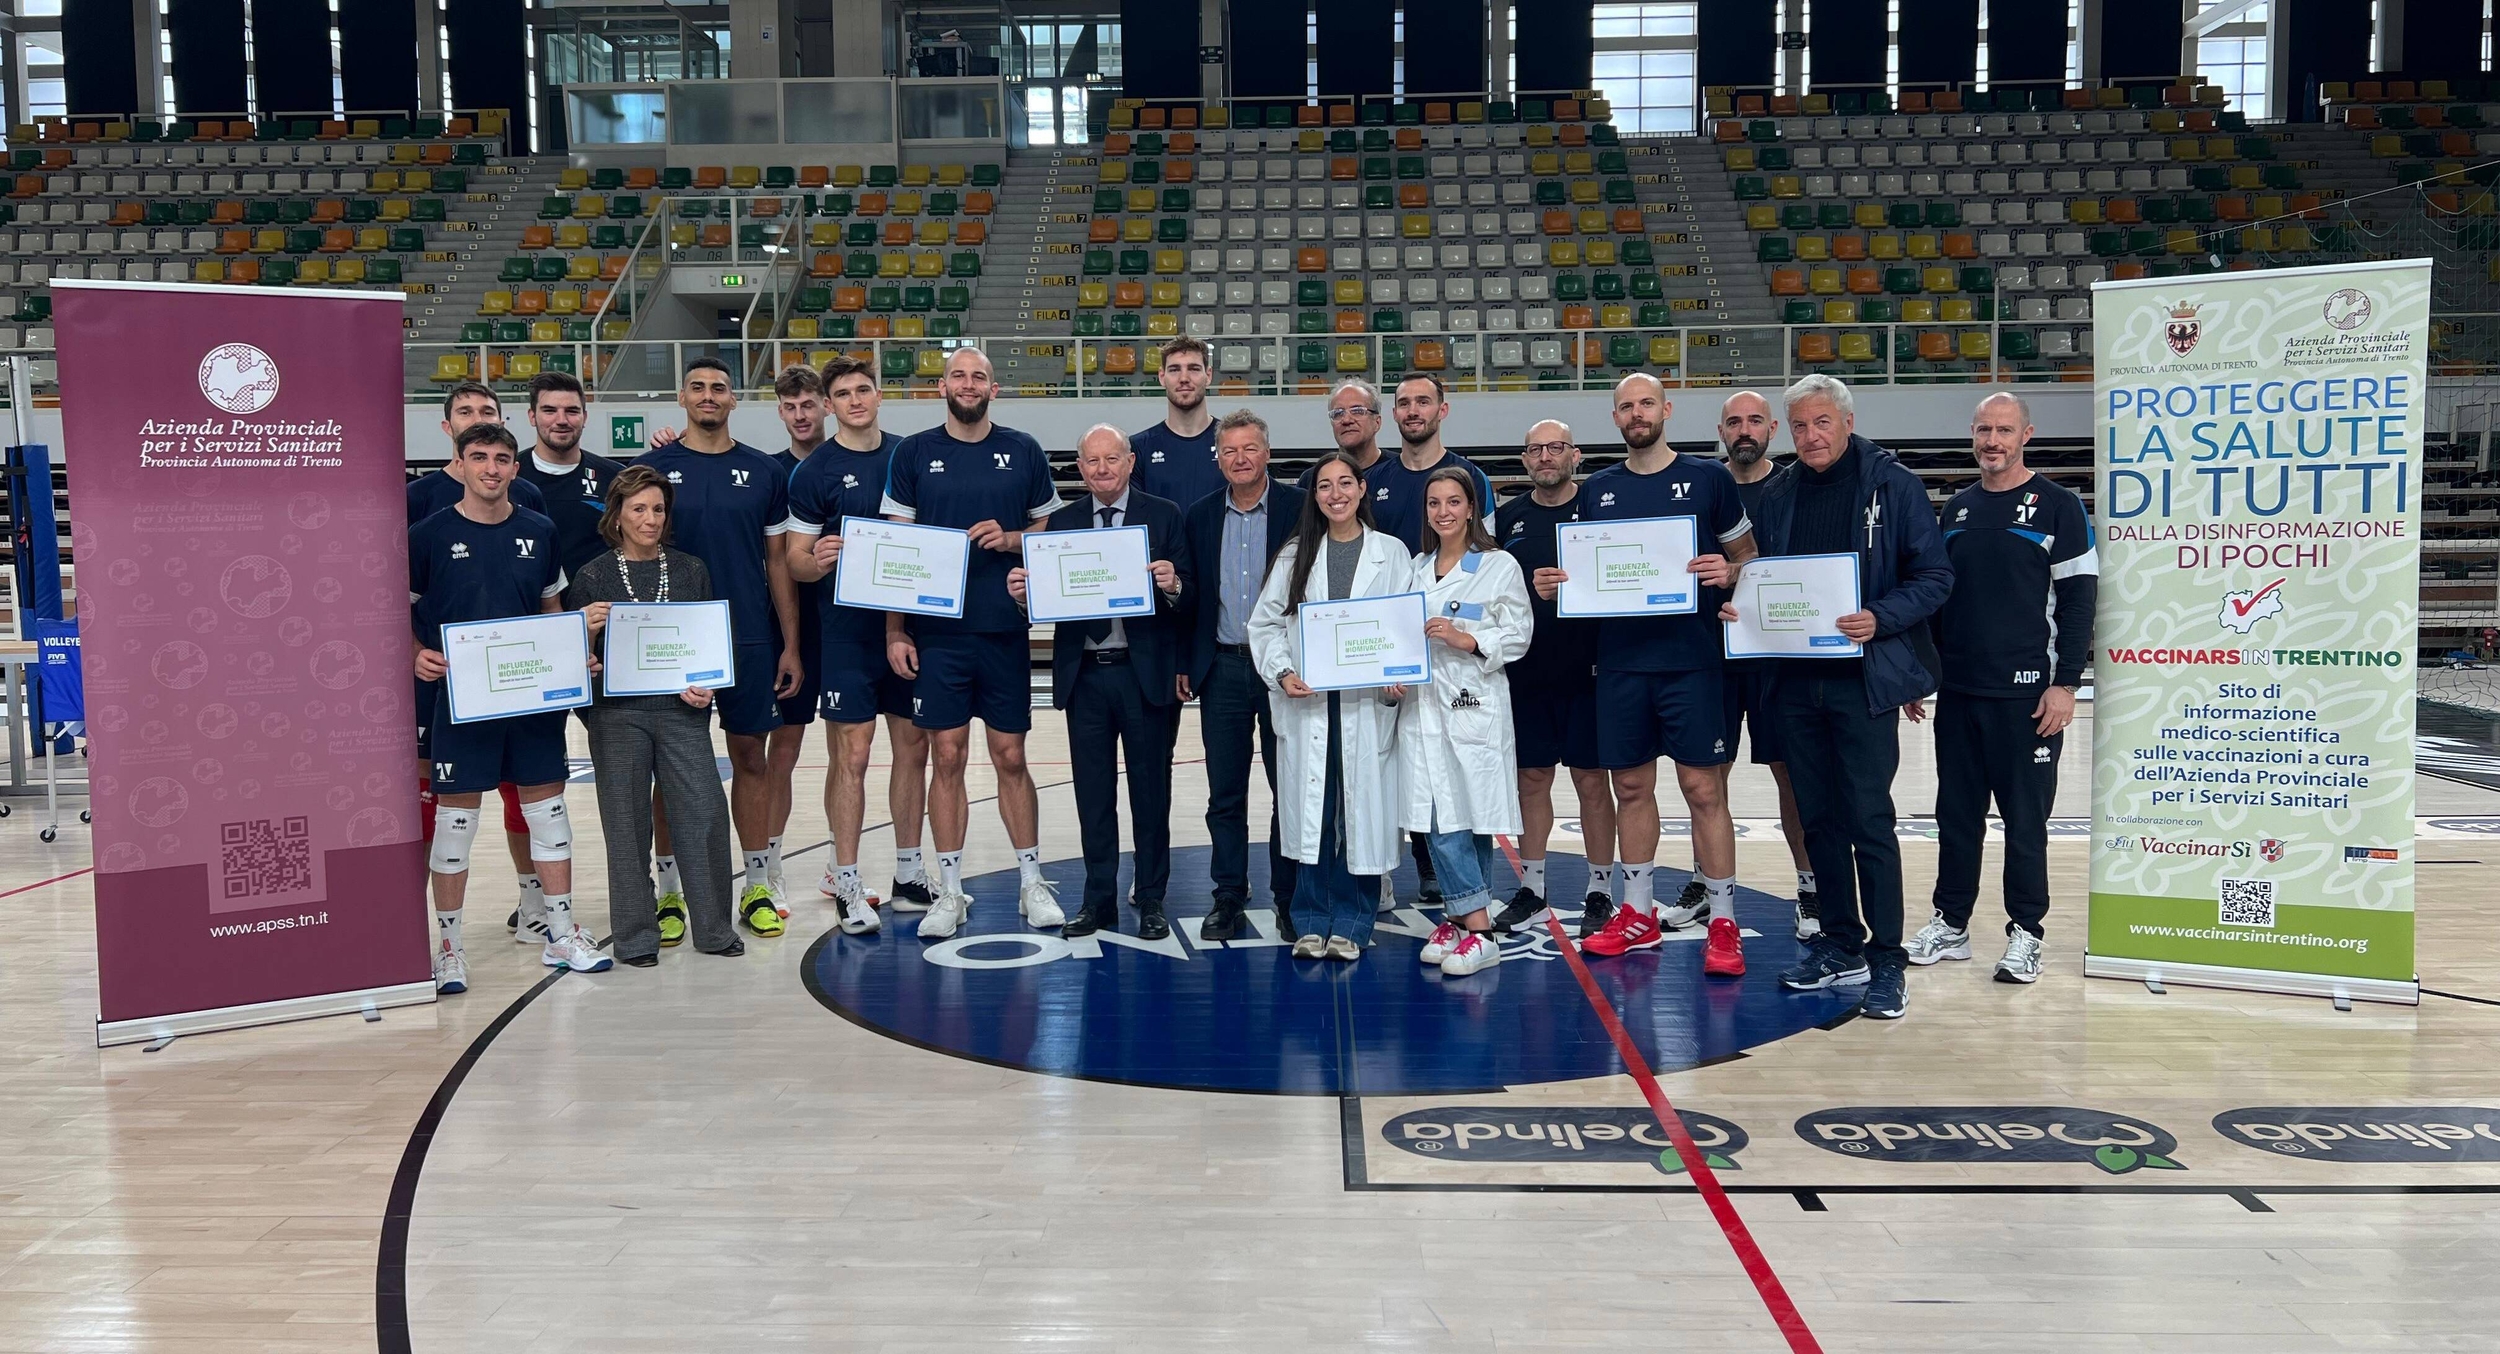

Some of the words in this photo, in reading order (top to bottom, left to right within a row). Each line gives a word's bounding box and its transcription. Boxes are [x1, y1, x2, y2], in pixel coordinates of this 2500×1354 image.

[1062, 186, 1081, 194] FILA
[470, 223, 476, 231] 7
[1073, 245, 1080, 253] 6
[1663, 268, 1685, 276] FILA
[1689, 267, 1696, 275] 5
[1043, 278, 1064, 286] FILA
[1068, 277, 1074, 285] 5
[402, 286, 423, 294] FILA
[427, 285, 433, 293] 5
[1674, 301, 1694, 310] FILA
[1699, 301, 1706, 309] 4
[1036, 311, 1058, 320] FILA
[1060, 311, 1068, 319] 4
[403, 319, 411, 327] 4
[2285, 335, 2335, 347] Azienda
[2339, 331, 2410, 344] Provinciale
[1030, 347, 1052, 355] FILA
[1055, 347, 1062, 355] 3
[2285, 349, 2304, 360] per
[2308, 348, 2312, 356] i
[2316, 345, 2358, 356] Servizi
[2361, 342, 2410, 353] Sanitari
[2110, 366, 2155, 375] PROVINCIA
[2158, 364, 2208, 373] AUTONOMA
[2212, 362, 2221, 370] DI
[2223, 361, 2258, 369] TRENTO
[2109, 376, 2409, 420] PROTEGGERE
[139, 419, 224, 436] Azienda
[230, 419, 342, 436] Provinciale
[2109, 424, 2174, 464] LA
[2190, 415, 2407, 461] SALUTE
[139, 439, 175, 457] per
[180, 437, 187, 452] i
[193, 437, 262, 452] Servizi
[266, 437, 342, 453] Sanitari
[140, 456, 208, 468] Provincia
[211, 456, 281, 467] Autonoma
[284, 455, 297, 467] di
[302, 456, 343, 467] Trento
[2108, 469, 2171, 518] DI
[2196, 461, 2407, 517] TUTTI
[2108, 525, 2178, 541] DALLA
[2185, 520, 2405, 540] DISINFORMAZIONE
[452, 551, 469, 559] errea
[2178, 545, 2209, 569] DI
[2221, 544, 2328, 569] POCHI
[883, 561, 925, 571] INFLUENZA?
[1606, 562, 1650, 571] INFLUENZA?
[1069, 568, 1109, 578] INFLUENZA?
[1767, 602, 1811, 611] INFLUENZA?
[646, 643, 687, 651] INFLUENZA?
[1345, 637, 1386, 647] INFLUENZA?
[498, 659, 543, 670] INFLUENZA?
[2014, 671, 2040, 683] ADP
[2218, 683, 2257, 699] Sito
[2263, 684, 2281, 699] di
[2184, 704, 2317, 722] informazione
[2160, 725, 2340, 744] medico-scientifica
[2034, 756, 2050, 764] errea
[2133, 746, 2177, 761] sulle
[2183, 750, 2302, 764] vaccinazioni
[2308, 754, 2319, 765] a
[2325, 754, 2370, 766] cura
[2134, 766, 2250, 784] dell’Azienda
[2256, 770, 2369, 788] Provinciale
[2152, 789, 2184, 805] per
[2189, 788, 2194, 802] i
[2200, 788, 2265, 806] Servizi
[2270, 791, 2348, 809] Sanitari
[2116, 816, 2183, 825] collaborazione
[2140, 837, 2251, 858] VaccinarSì
[210, 911, 328, 938] www.apss.tn.it
[2129, 923, 2368, 954] www.vaccinarsintrentino.org
[1402, 1122, 1730, 1150] Melinda
[1813, 1122, 2155, 1150] Melinda
[2231, 1123, 2500, 1150] elinda
